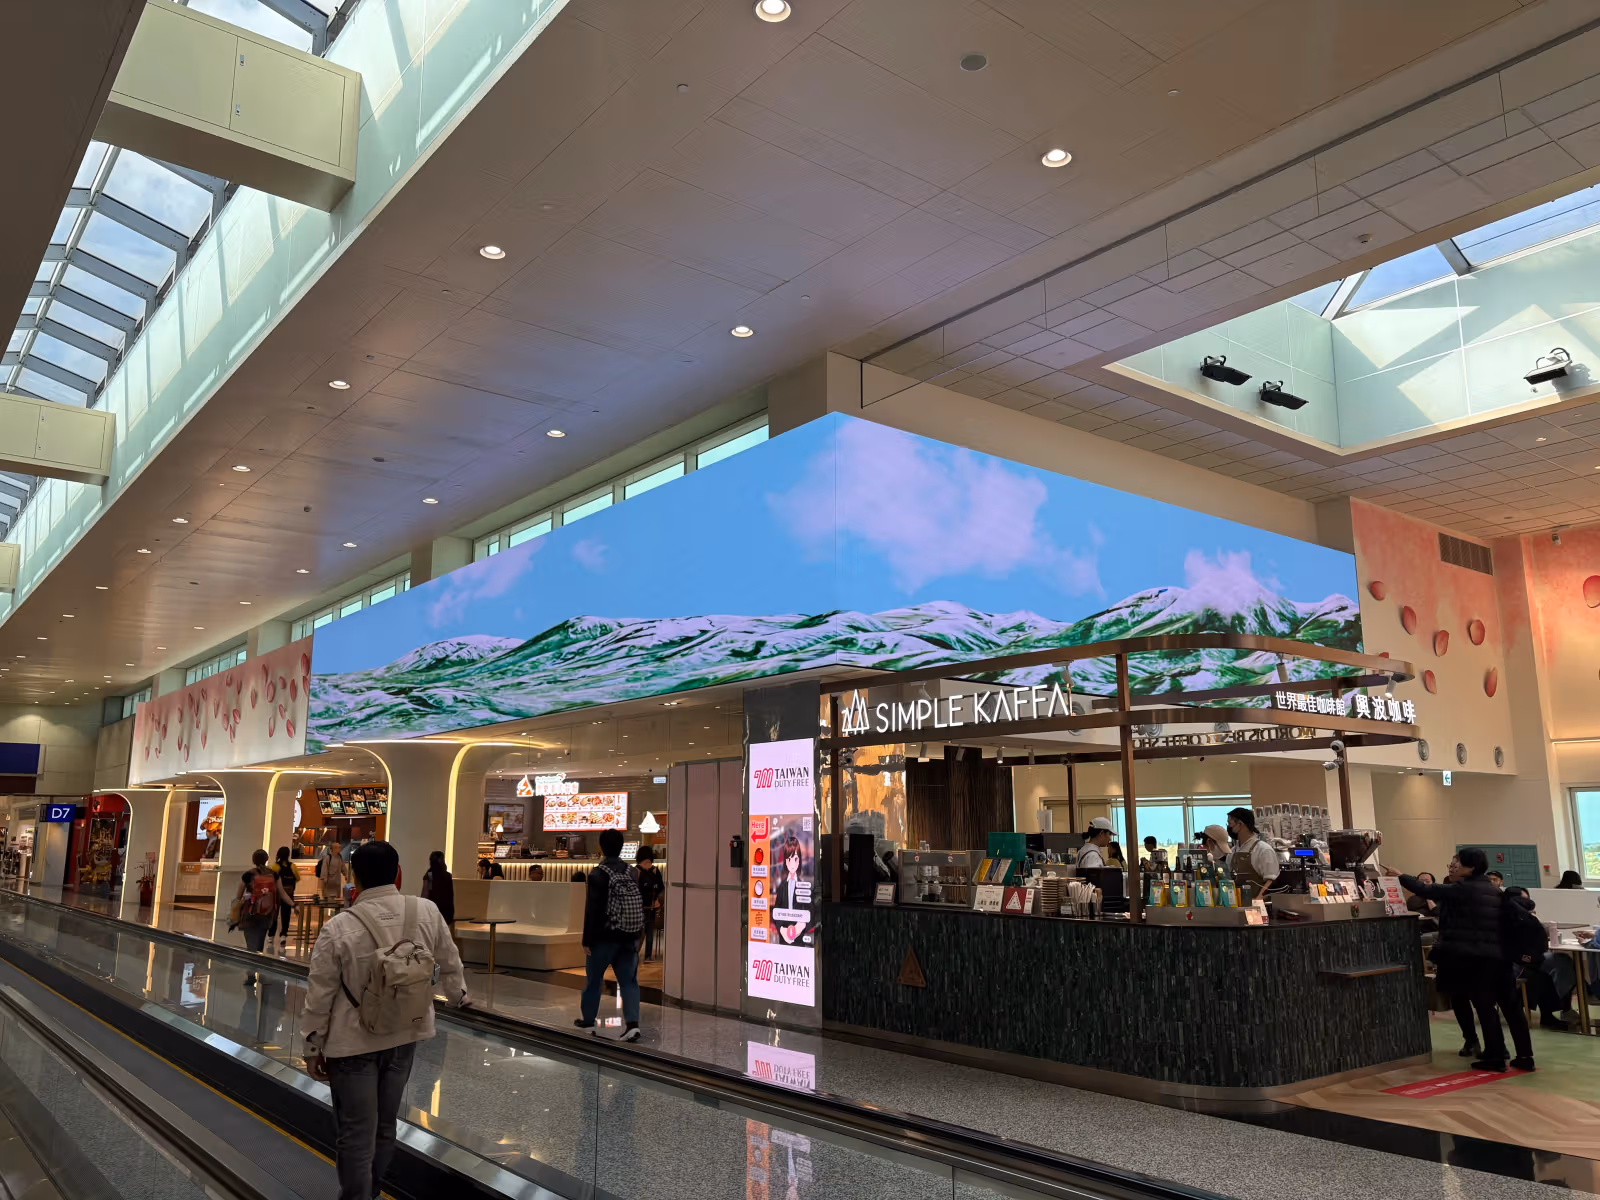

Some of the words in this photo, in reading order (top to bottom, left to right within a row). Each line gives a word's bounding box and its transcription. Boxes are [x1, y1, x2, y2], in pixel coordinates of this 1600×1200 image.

[876, 695, 964, 733] SIMPLE
[973, 682, 1070, 725] KAFFA
[1275, 690, 1346, 717] 世界最佳咖啡館
[1355, 693, 1417, 724] 興波咖啡
[774, 767, 809, 779] TAIWAN
[774, 780, 791, 788] DUTY
[792, 778, 809, 787] FREE
[51, 807, 70, 819] D7
[751, 820, 765, 829] Here
[774, 962, 810, 978] TAIWAN
[774, 974, 792, 984] DUTY
[792, 977, 810, 988] FREE
